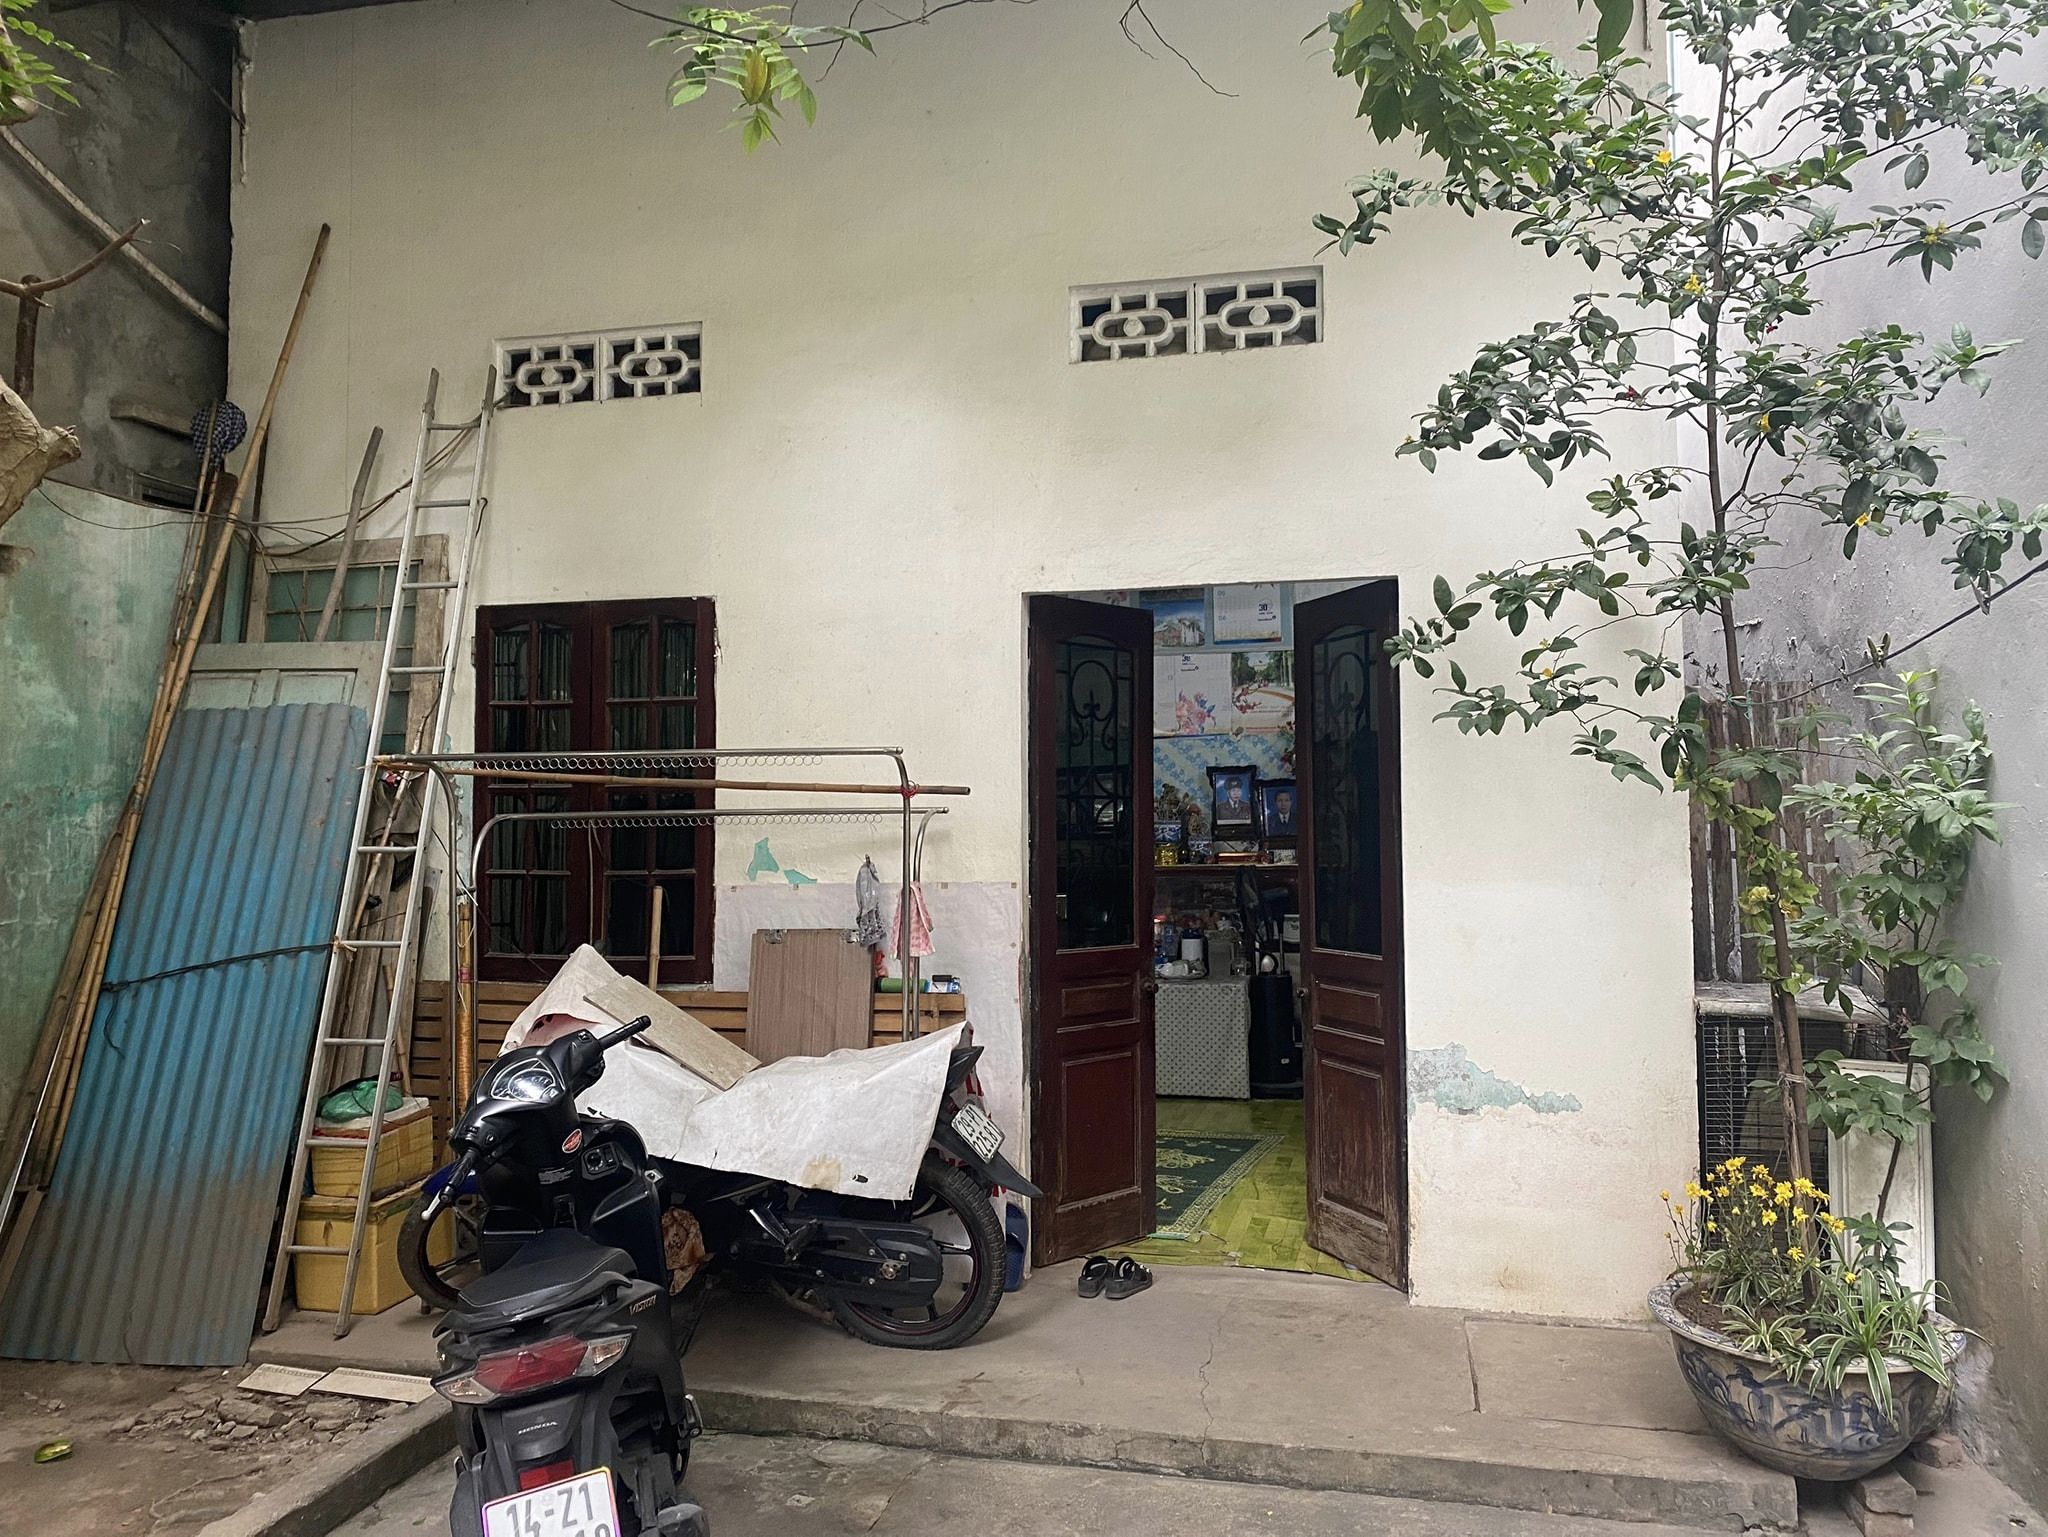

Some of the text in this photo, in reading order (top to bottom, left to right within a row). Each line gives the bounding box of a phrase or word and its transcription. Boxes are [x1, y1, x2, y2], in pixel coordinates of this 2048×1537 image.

[973, 1121, 1003, 1157] 225.81
[517, 1420, 558, 1435] HONDA
[506, 1481, 594, 1537] 14-Z1
